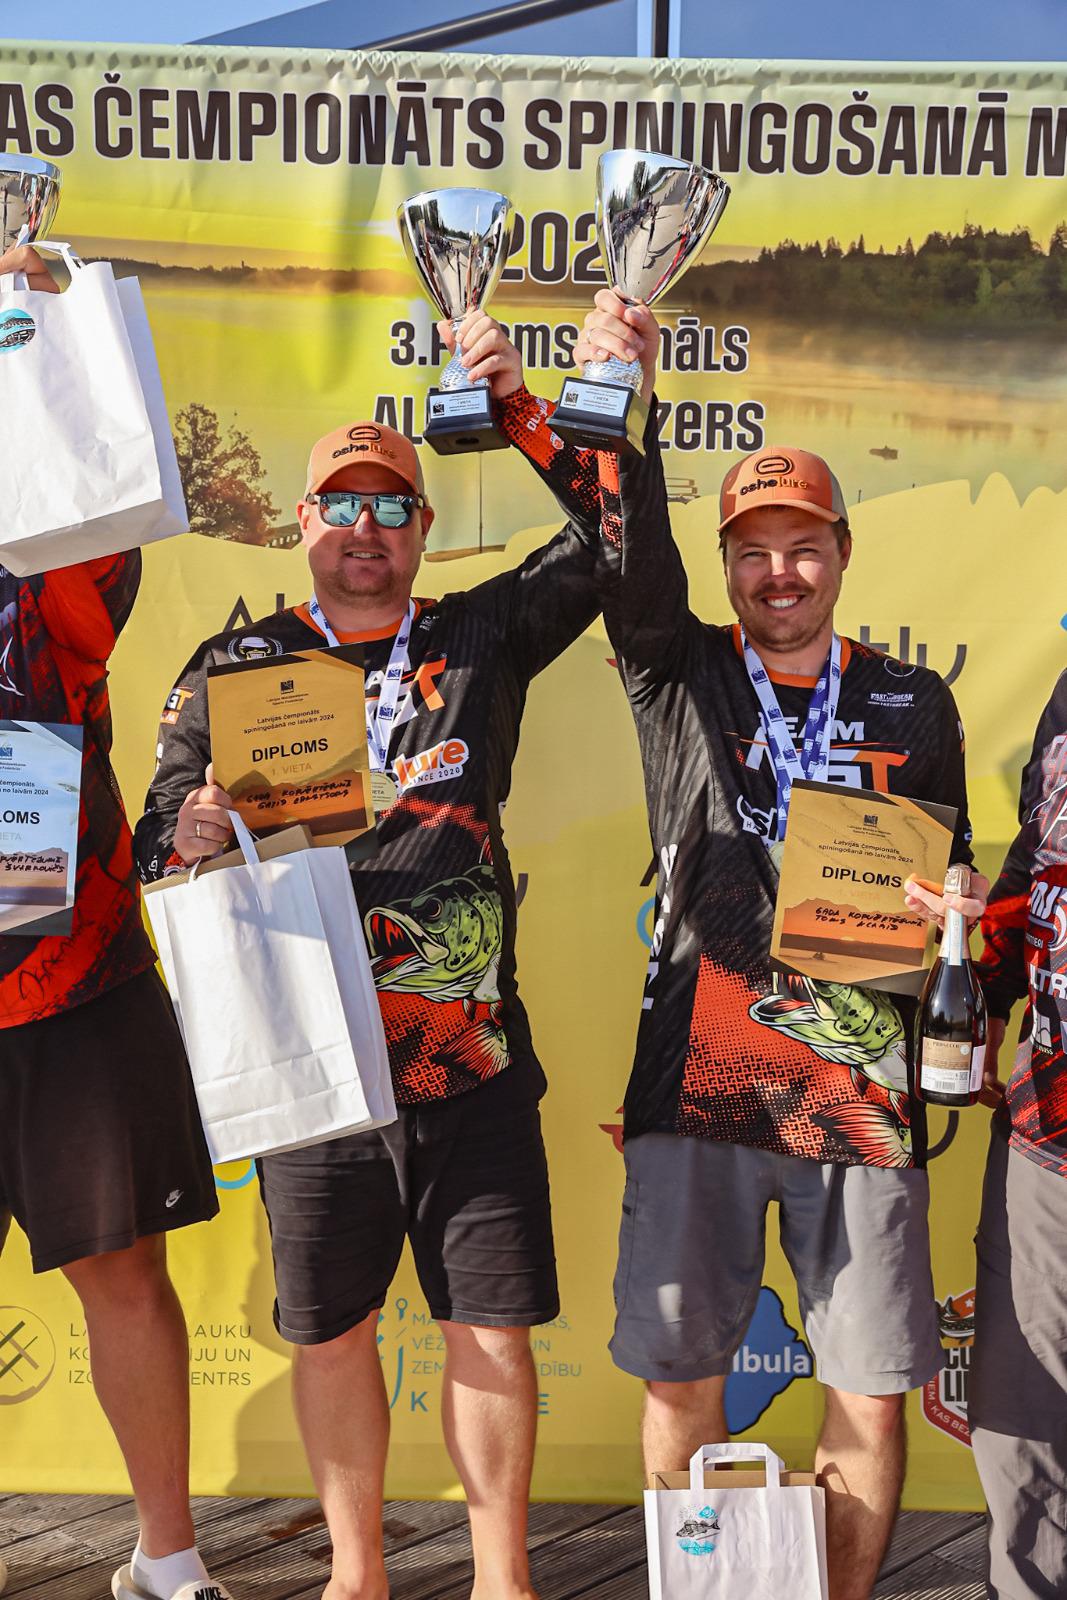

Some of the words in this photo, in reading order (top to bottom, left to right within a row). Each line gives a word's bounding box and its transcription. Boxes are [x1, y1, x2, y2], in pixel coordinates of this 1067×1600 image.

[94, 73, 505, 169] ČEMPIONĀTS
[524, 91, 1008, 176] SPININGOŠANĀ
[498, 211, 609, 282] 202
[243, 721, 287, 735] spiningošanā
[297, 717, 318, 725] laivām
[319, 714, 335, 722] 2024
[257, 714, 282, 724] Latvijas
[283, 709, 320, 720] čempionāts
[252, 738, 329, 762] DIPLOMS
[282, 763, 312, 775] VIETA
[438, 766, 460, 778] 2020
[12, 787, 32, 795] laivām
[818, 844, 863, 855] spiningošanā
[874, 851, 897, 860] laivām
[898, 856, 914, 864] 2024
[833, 838, 860, 849] Latvijas
[860, 842, 900, 855] čempionāts
[822, 866, 902, 888] DIPLOMS
[816, 906, 840, 917] GADA
[189, 1324, 251, 1338] AUKU
[225, 1349, 251, 1362] UN
[191, 1371, 251, 1386] ENTRS
[930, 1405, 951, 1424] KAS
